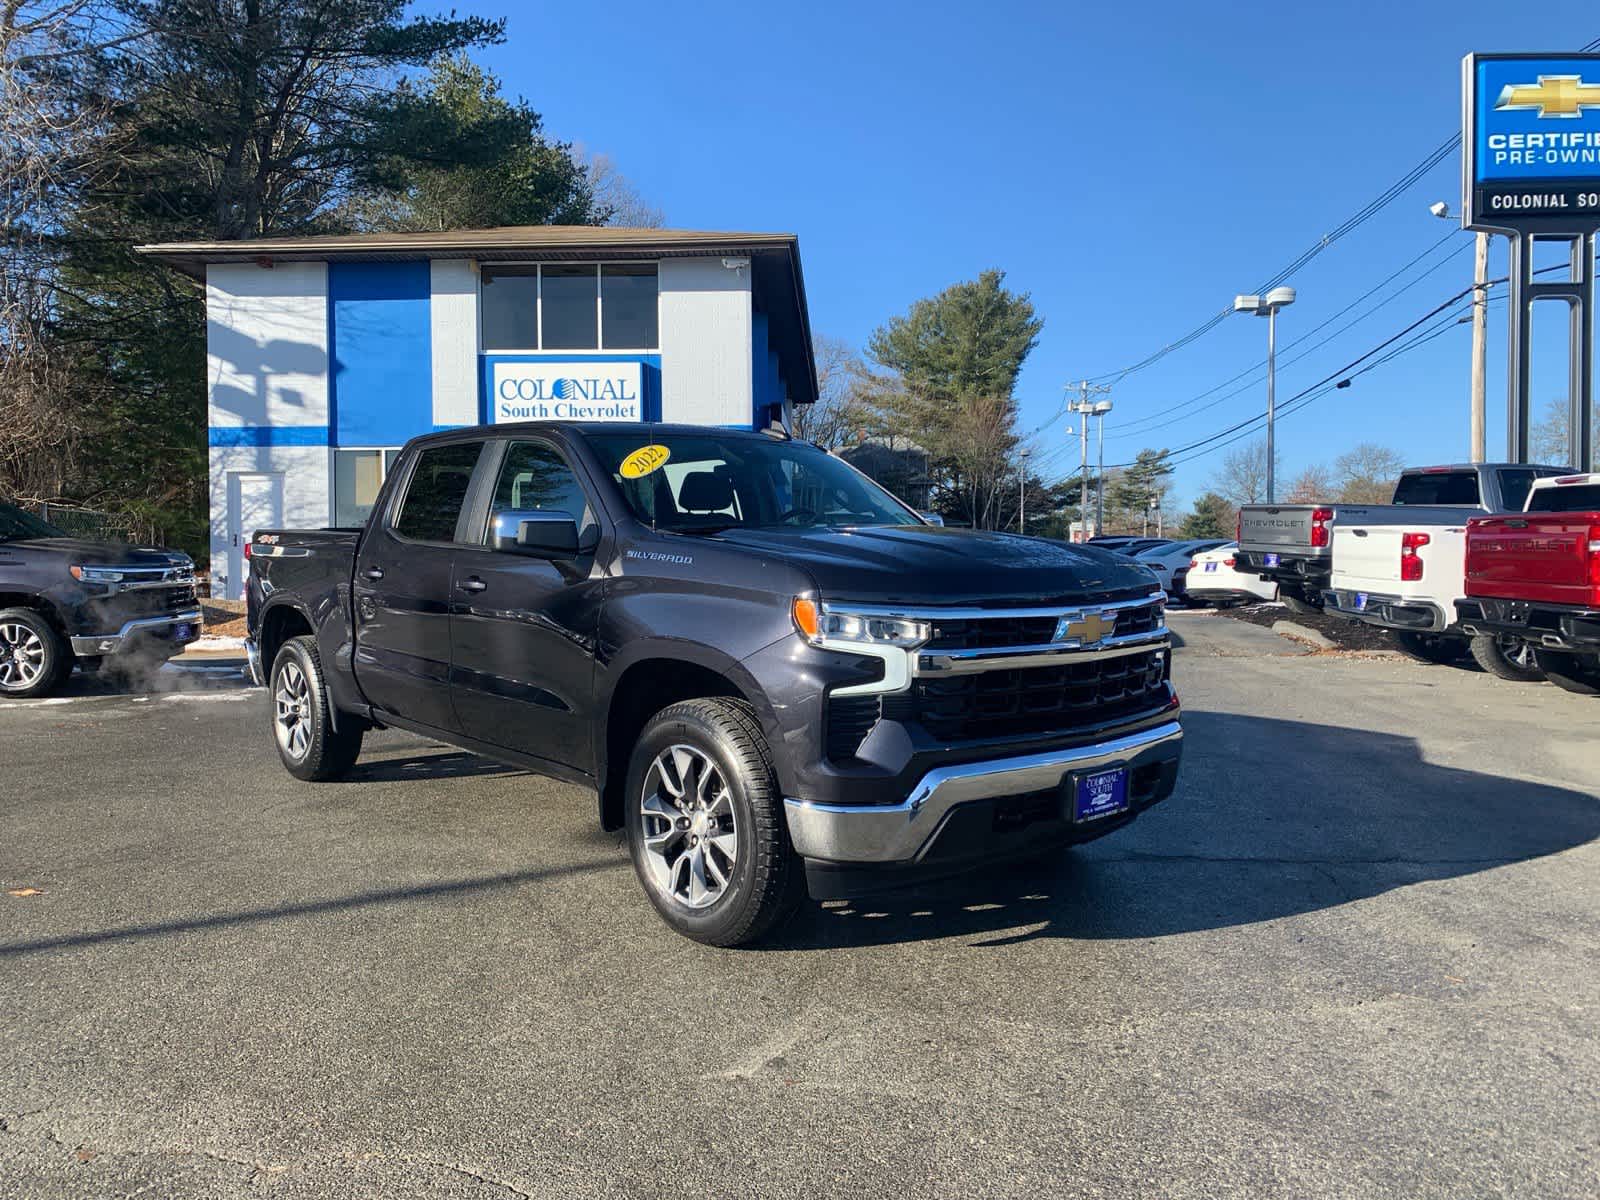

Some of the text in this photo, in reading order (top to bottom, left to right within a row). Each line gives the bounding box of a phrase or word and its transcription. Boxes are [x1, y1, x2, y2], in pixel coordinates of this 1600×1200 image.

[1496, 149, 1600, 164] PRE-OWN
[1492, 193, 1600, 209] COLONIAL SO
[500, 378, 636, 401] COLONIAL
[501, 403, 636, 418] South Chevrolet
[630, 448, 663, 473] 2022
[1244, 519, 1305, 529] CHEVROLET
[626, 550, 694, 564] SILVERADO
